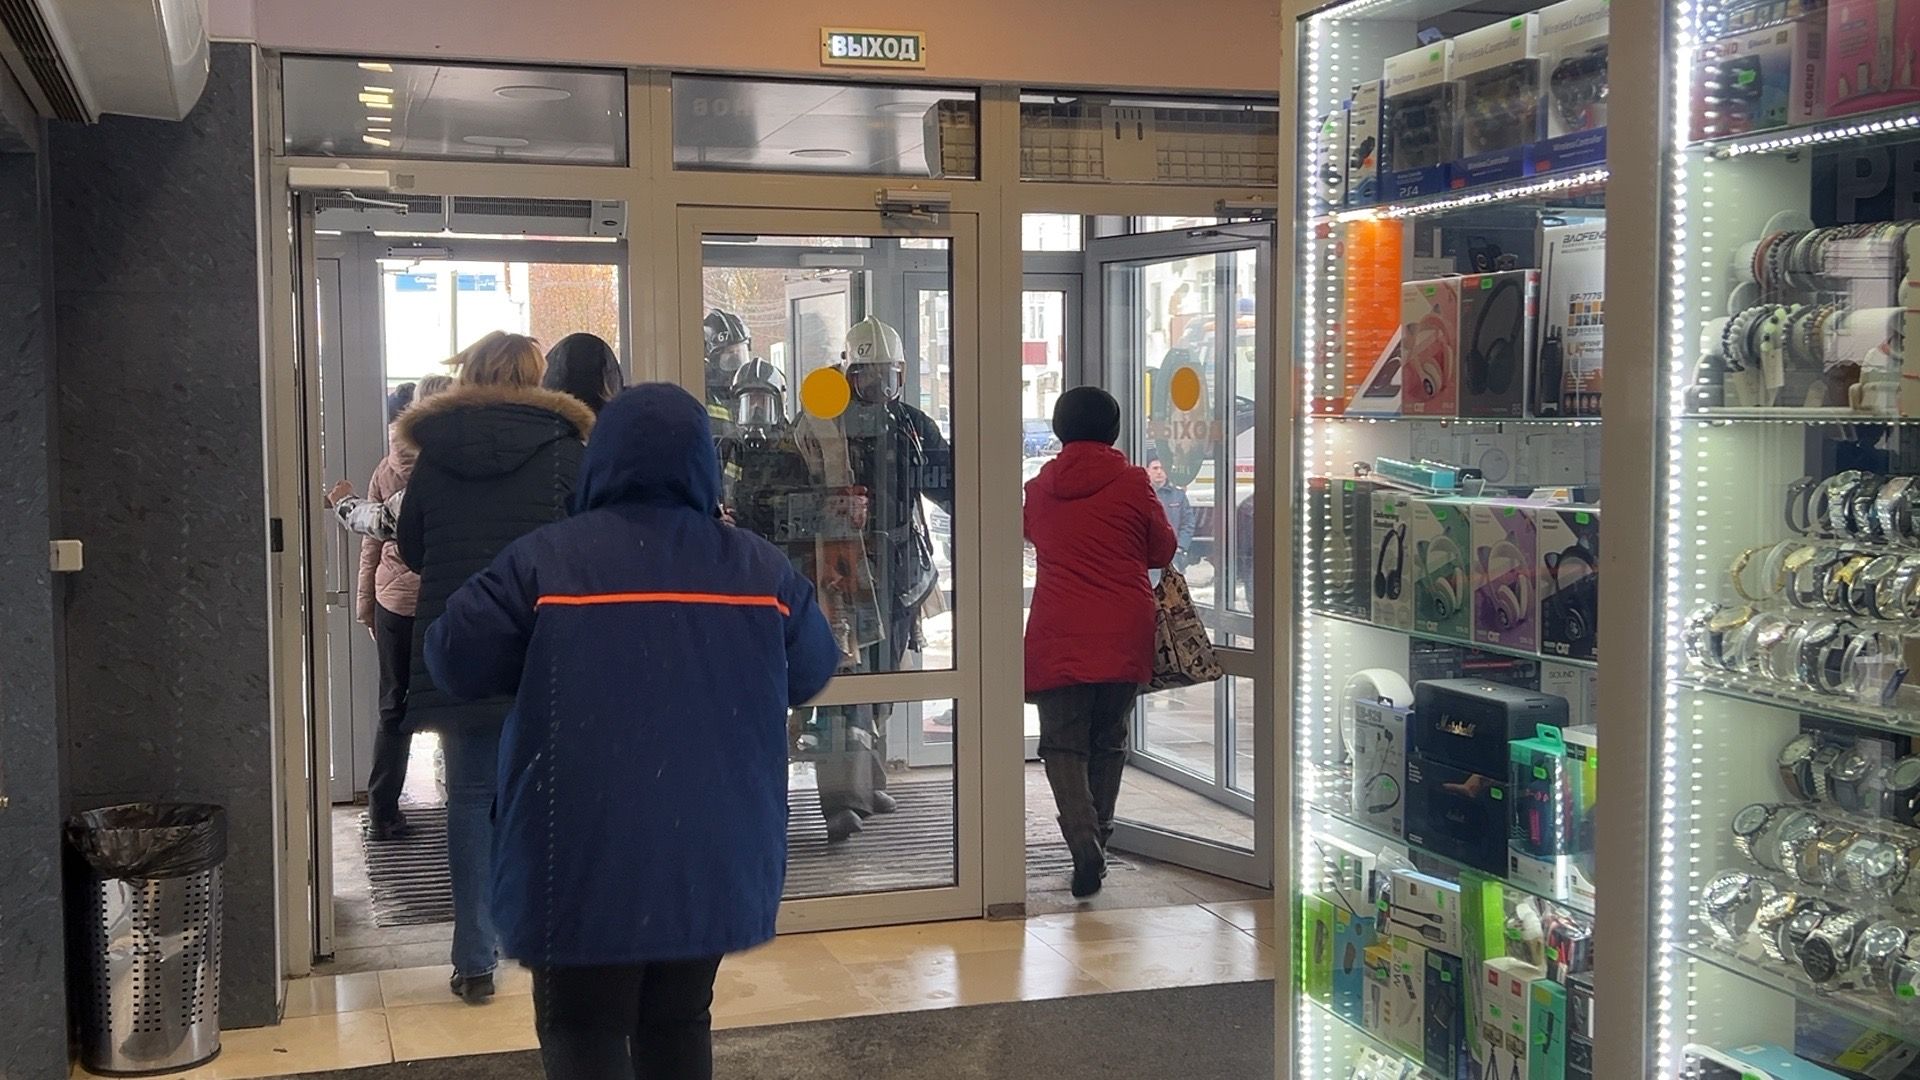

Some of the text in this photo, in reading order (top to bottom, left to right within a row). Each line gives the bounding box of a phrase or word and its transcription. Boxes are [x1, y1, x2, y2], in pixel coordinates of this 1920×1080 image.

[831, 34, 916, 61] ВЫХОД
[1804, 63, 1815, 116] LEGEND
[1400, 186, 1419, 197] PS4
[717, 331, 729, 342] 67
[857, 343, 872, 356] 67
[1549, 669, 1575, 679] SOUND
